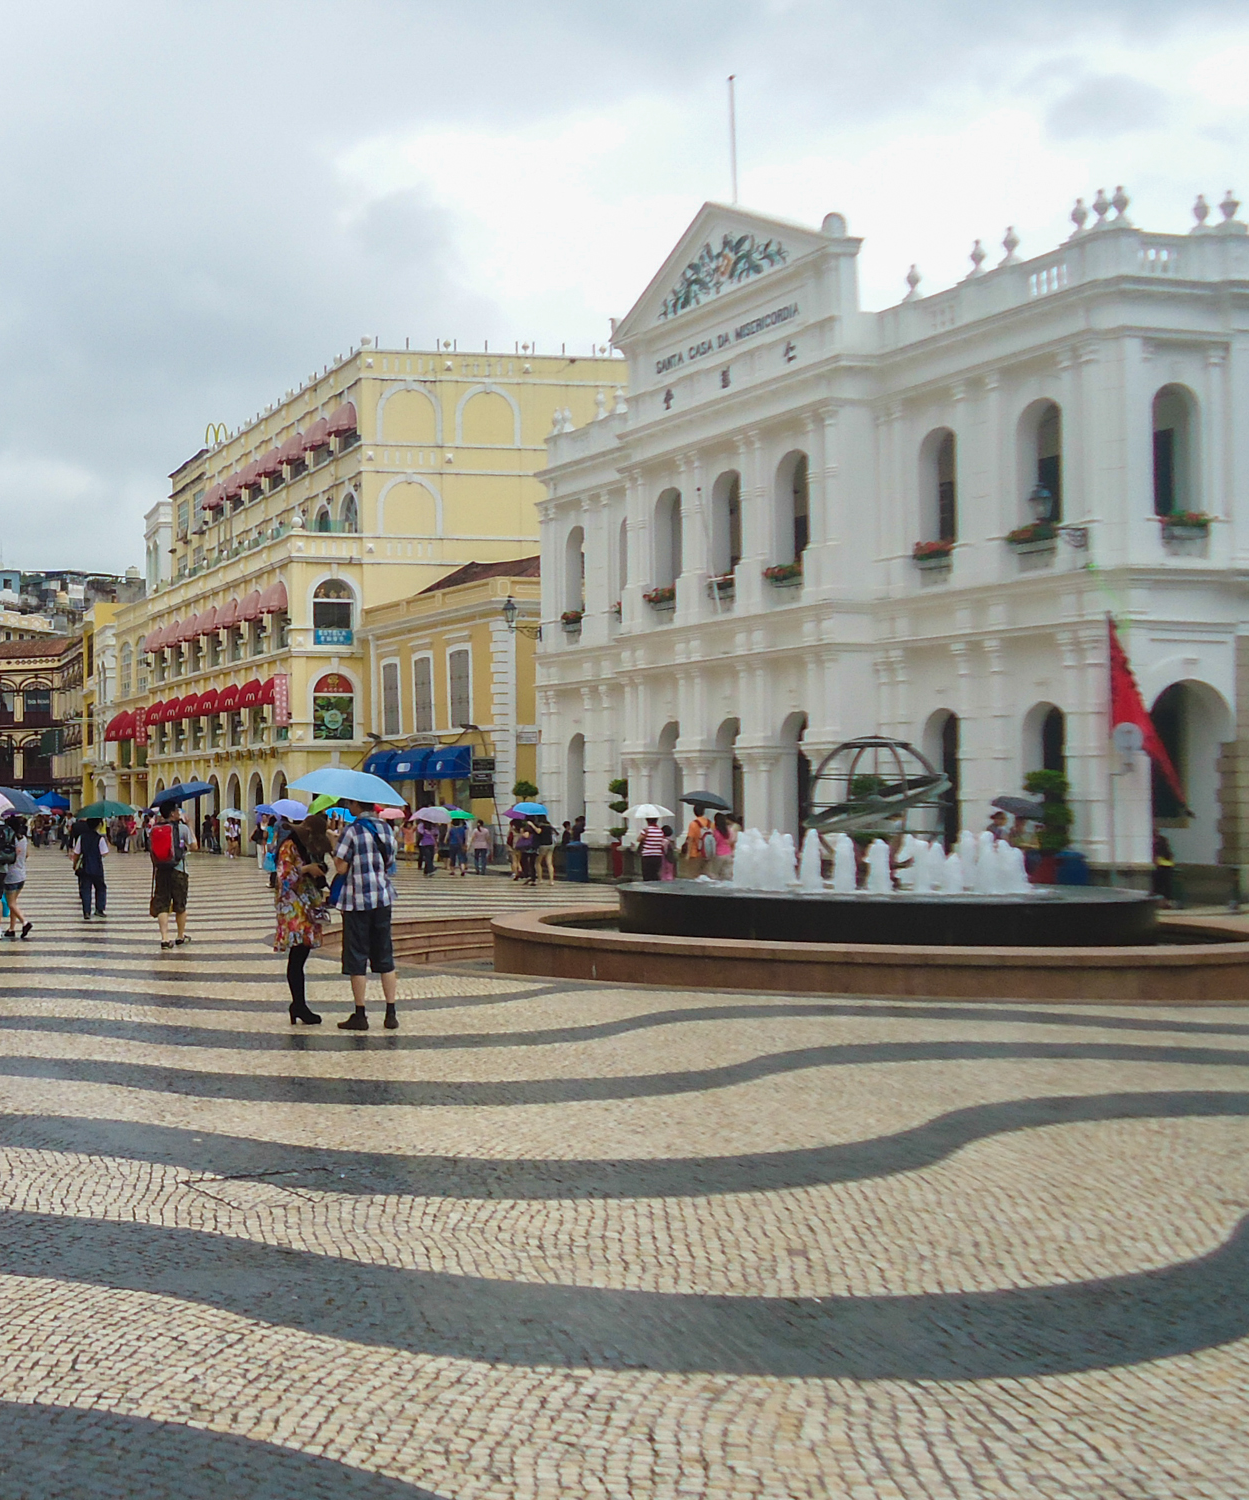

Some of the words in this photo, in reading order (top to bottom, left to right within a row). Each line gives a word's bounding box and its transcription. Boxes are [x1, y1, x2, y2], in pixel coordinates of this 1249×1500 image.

[655, 351, 685, 375] SANTA
[687, 338, 714, 361] CASA
[717, 332, 731, 349] DA
[735, 302, 800, 341] MISERICORDIA
